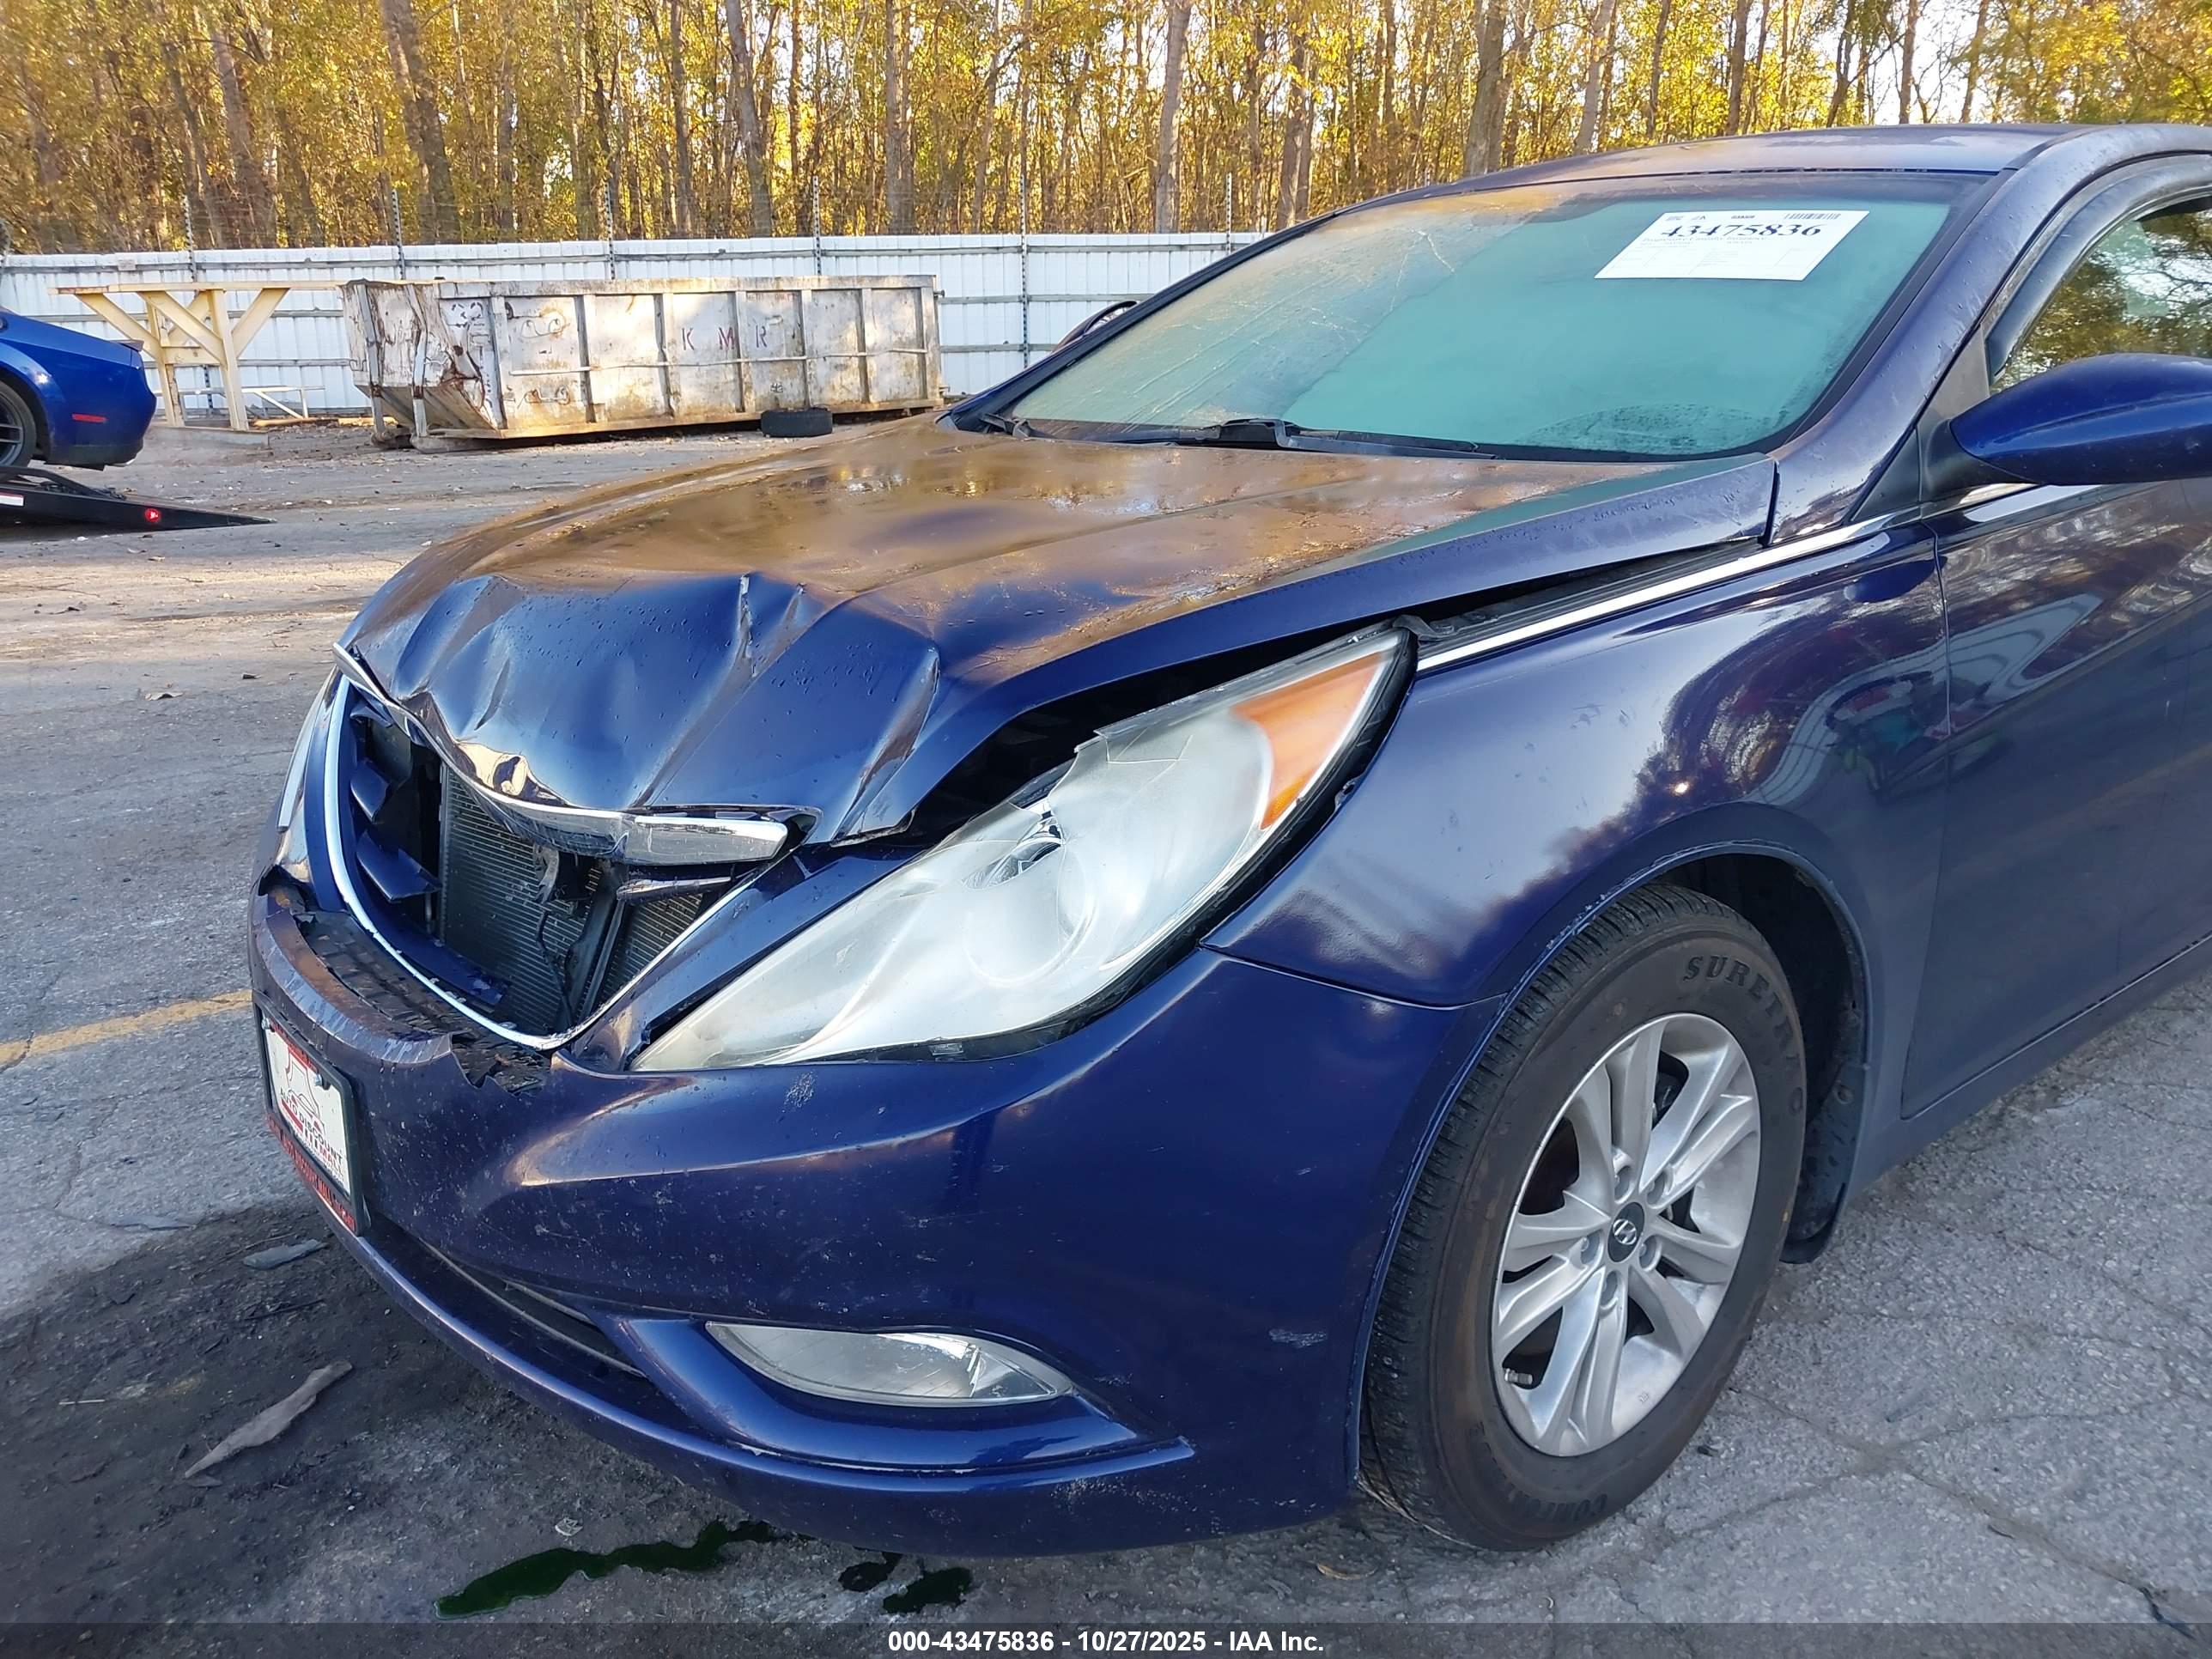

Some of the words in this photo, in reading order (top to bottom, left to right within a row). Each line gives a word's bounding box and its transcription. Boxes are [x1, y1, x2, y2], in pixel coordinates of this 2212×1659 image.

[1661, 223, 1826, 237] 43475836
[681, 327, 695, 351] K
[718, 326, 736, 350] M
[280, 1087, 298, 1115] AUTO
[299, 1112, 343, 1164] DISCOUNT
[319, 1144, 344, 1175] MALL
